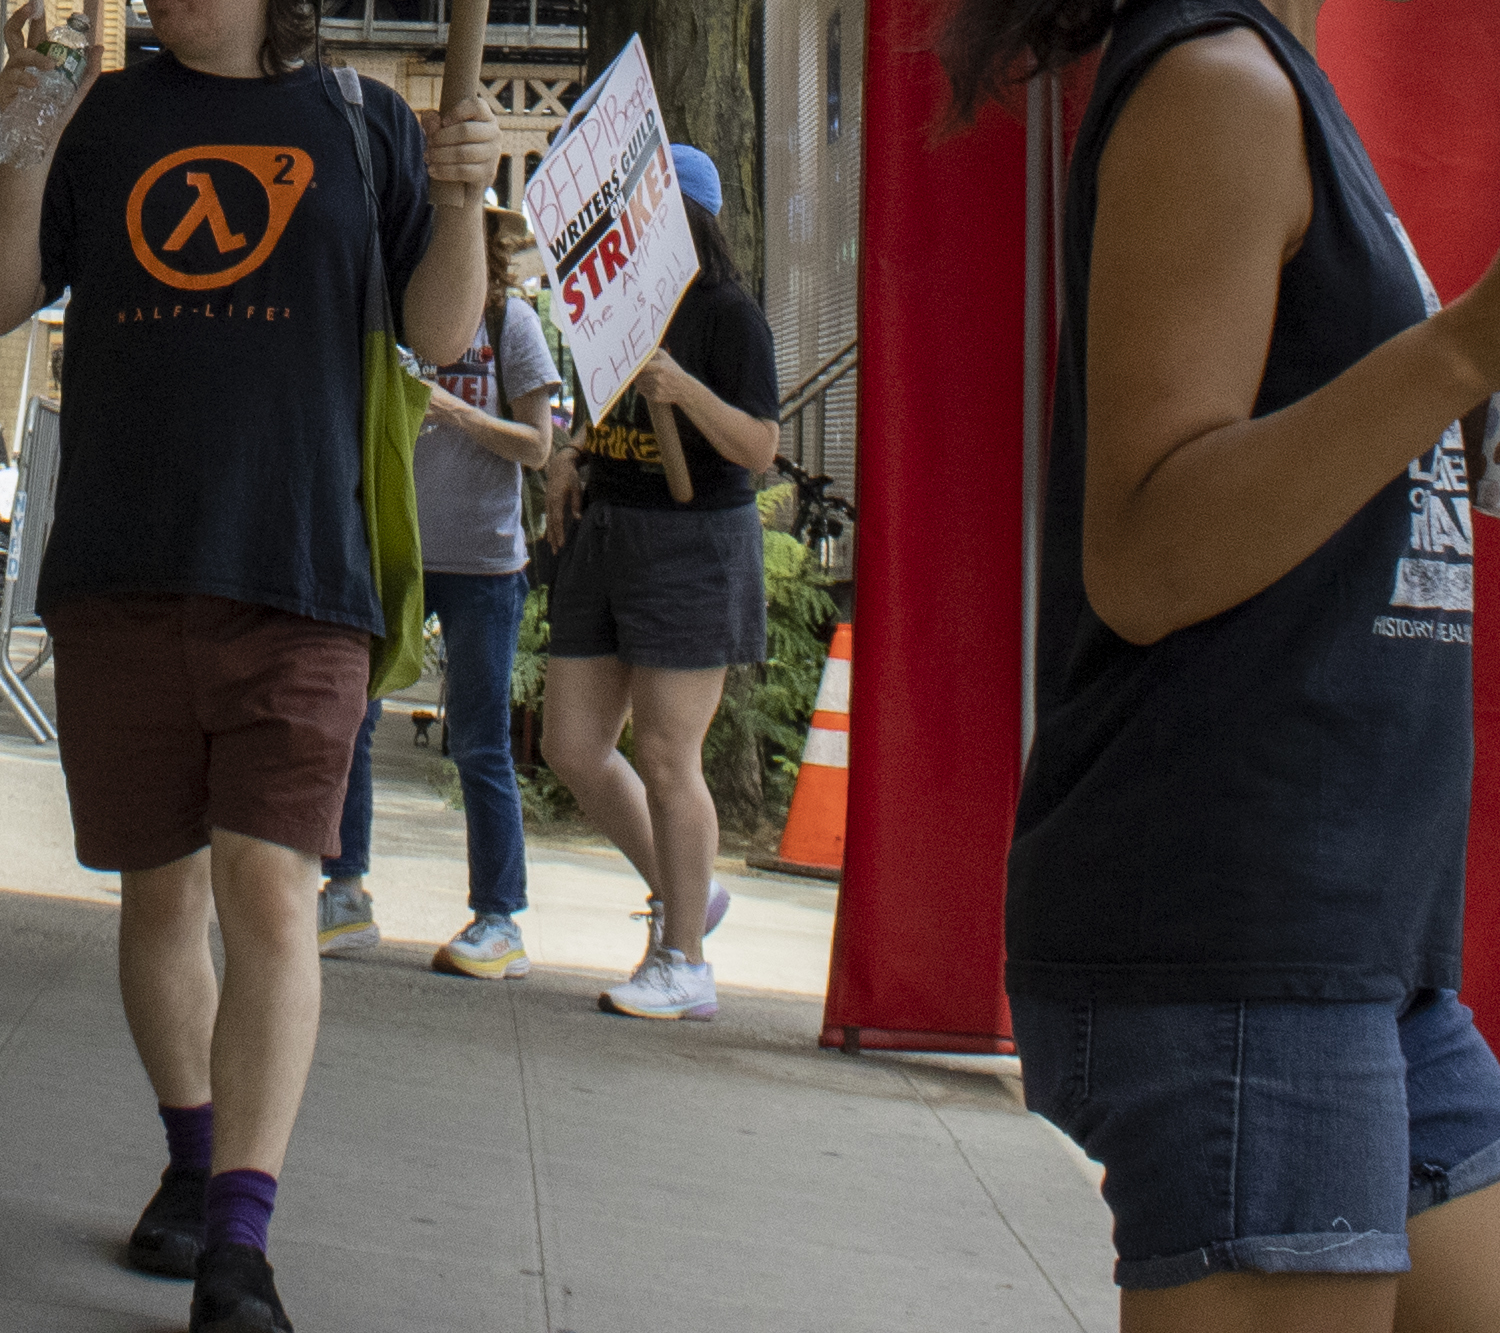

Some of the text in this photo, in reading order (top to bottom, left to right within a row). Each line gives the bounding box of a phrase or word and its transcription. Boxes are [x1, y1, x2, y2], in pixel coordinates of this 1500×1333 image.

[549, 108, 656, 263] WRITERS GUILD
[562, 144, 671, 326] STRIKE!
[609, 193, 627, 220] ON
